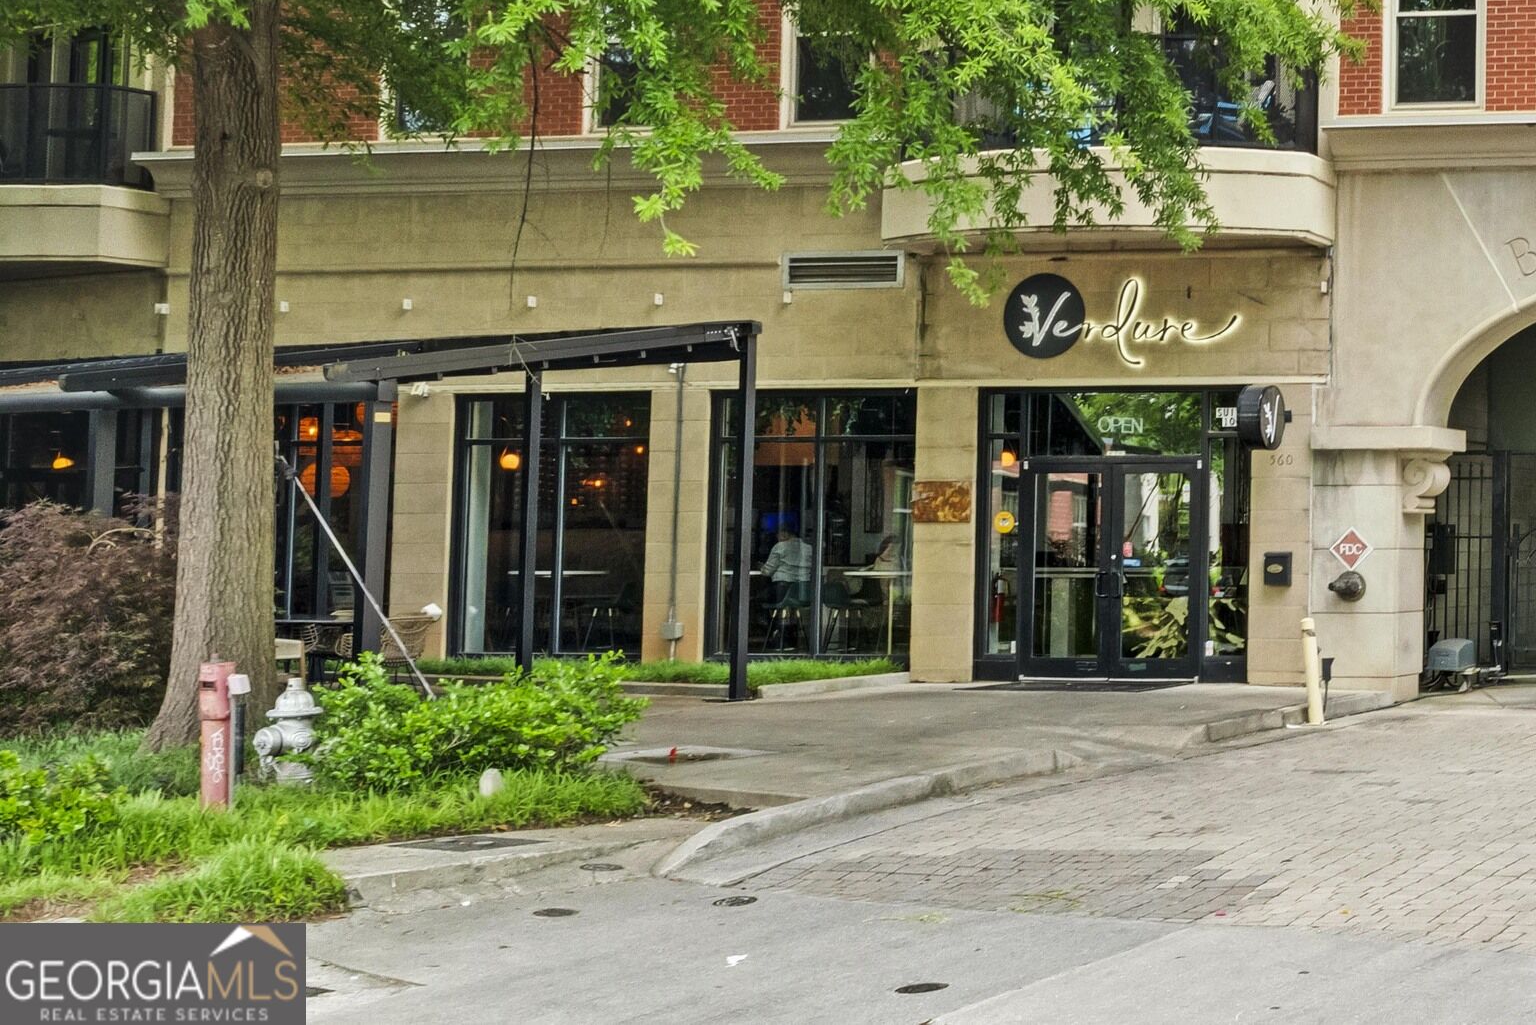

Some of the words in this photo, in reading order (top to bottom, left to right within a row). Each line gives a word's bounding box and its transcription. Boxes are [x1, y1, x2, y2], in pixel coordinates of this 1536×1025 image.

[1019, 278, 1238, 365] Verdure
[1098, 416, 1143, 434] OPEN
[1270, 454, 1294, 466] 560
[1339, 543, 1363, 555] FDC
